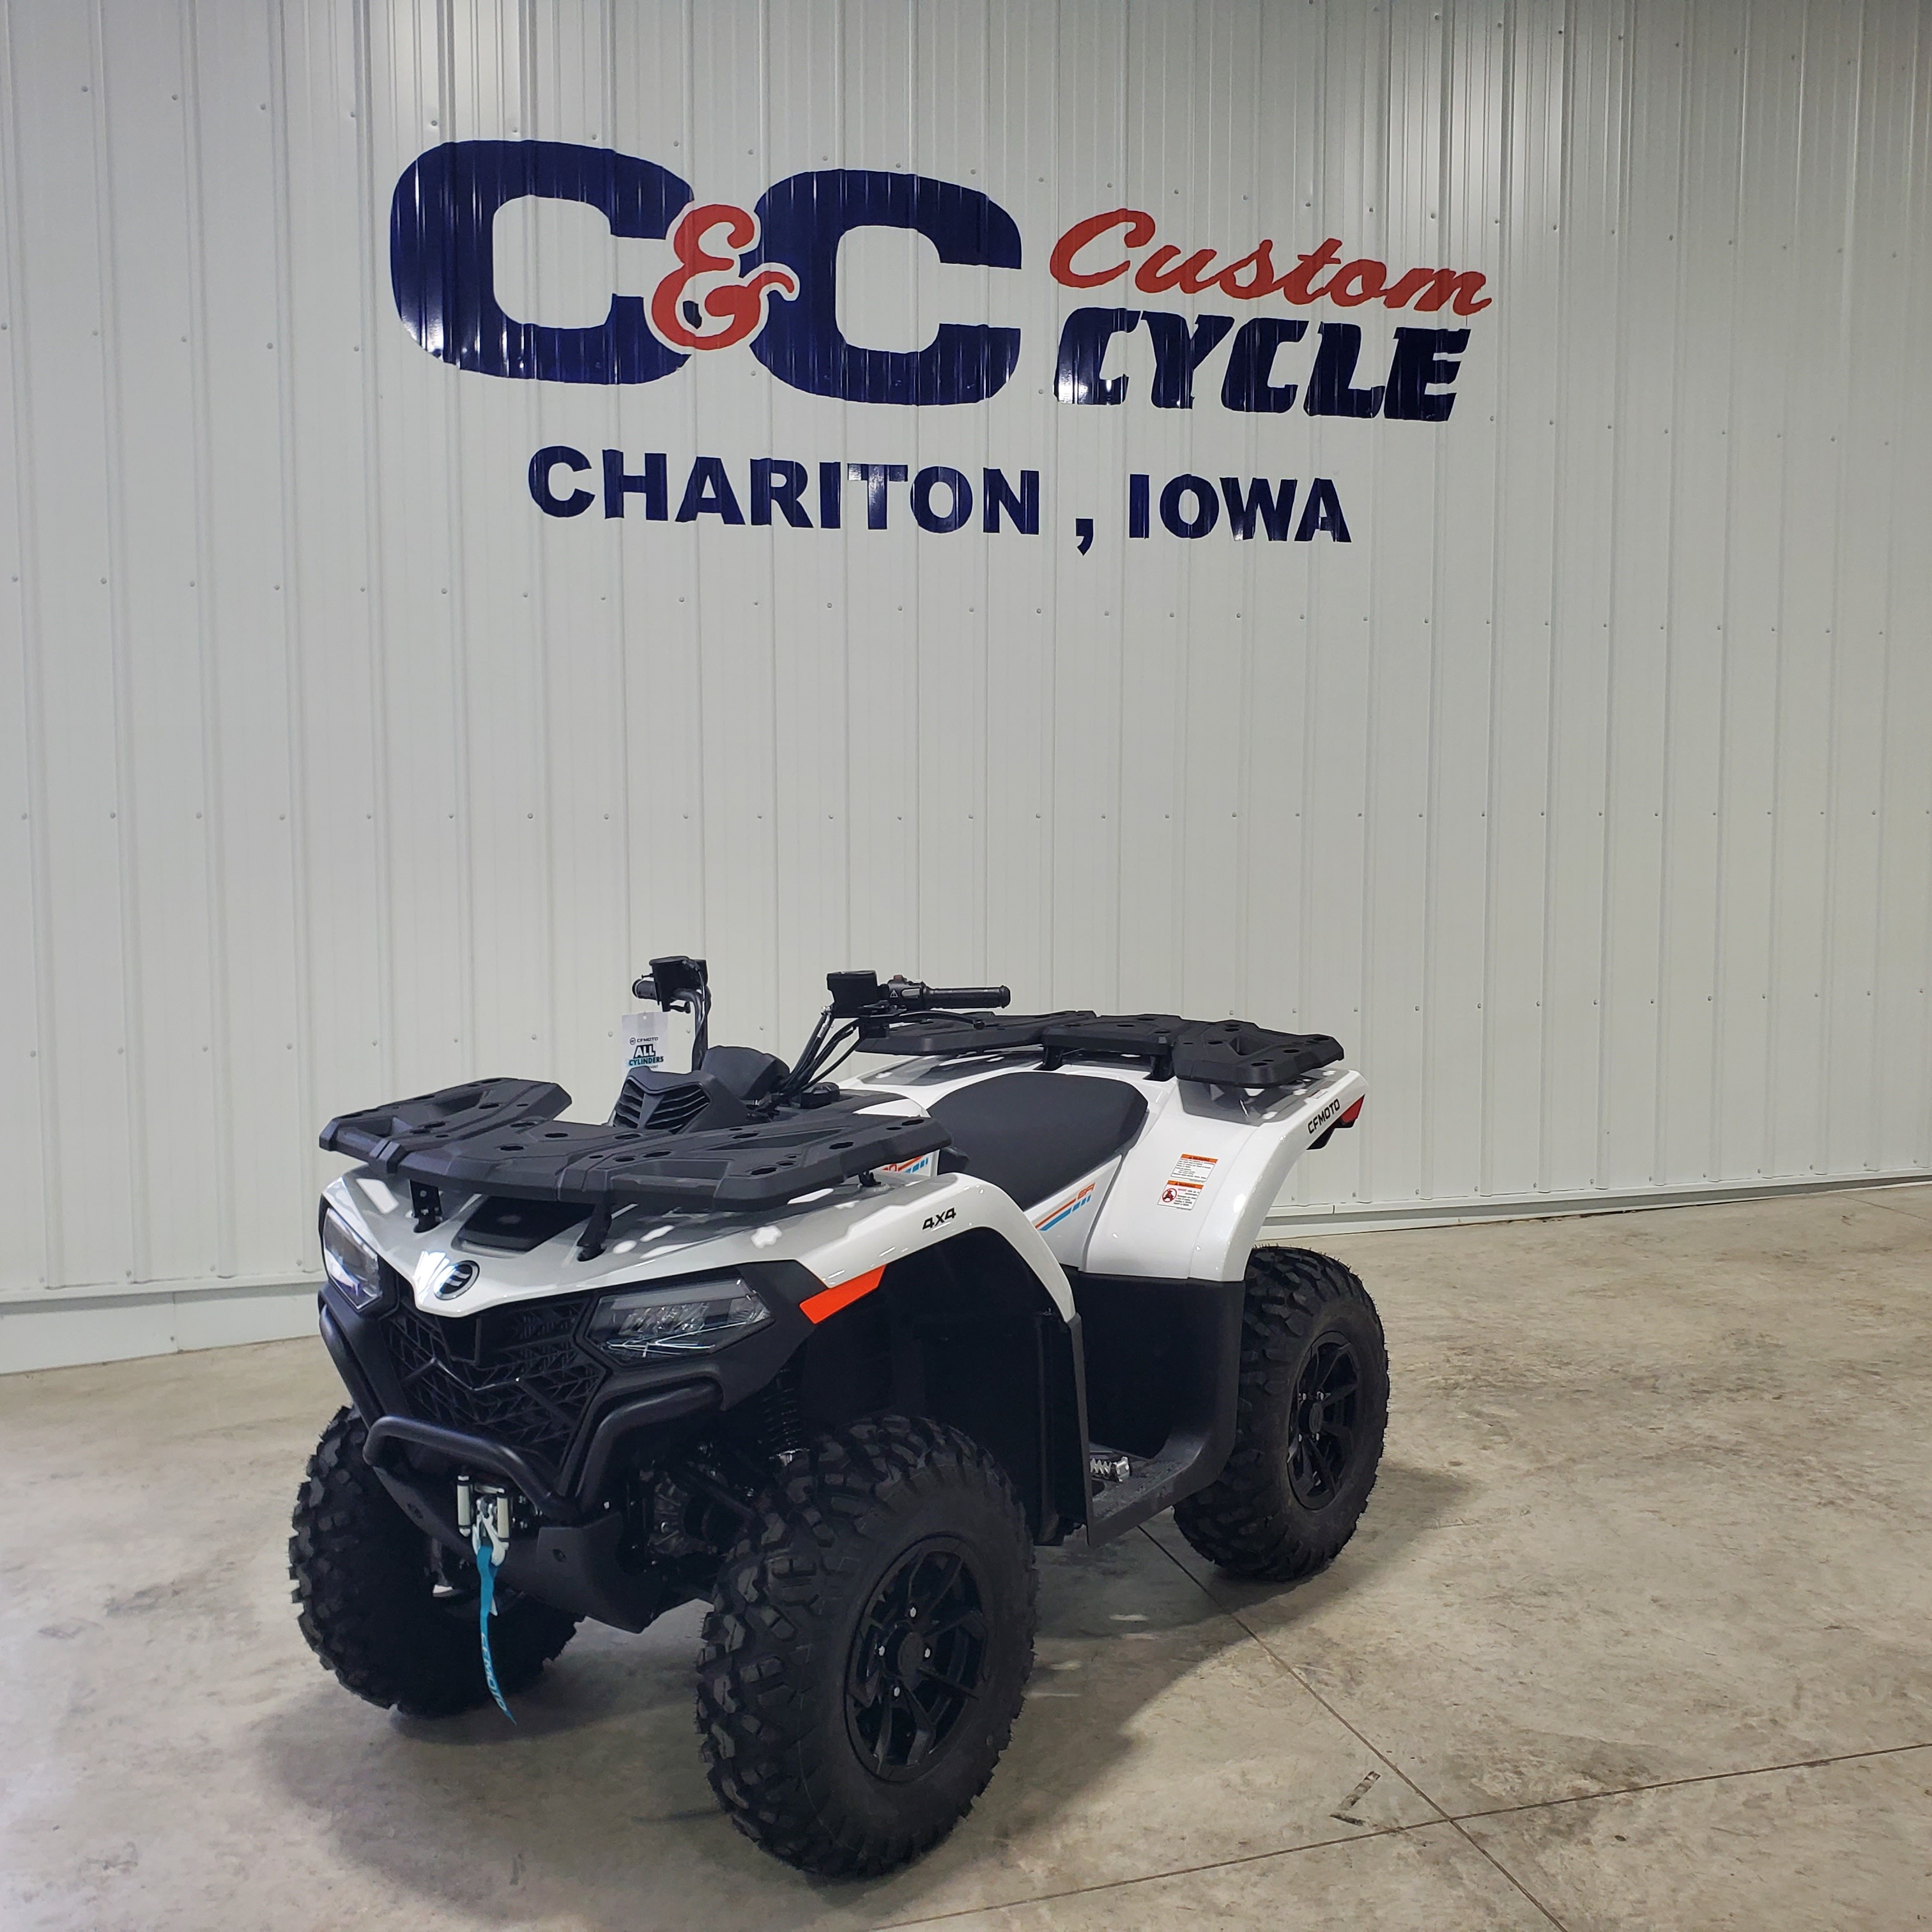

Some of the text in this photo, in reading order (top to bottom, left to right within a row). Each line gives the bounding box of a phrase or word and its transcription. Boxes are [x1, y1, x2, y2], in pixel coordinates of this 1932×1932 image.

[390, 140, 1022, 406] C&C
[1050, 209, 1491, 315] Custom
[1054, 307, 1471, 422] CYCLE
[529, 446, 1039, 535] CHARITON
[1130, 474, 1351, 542] IOWA
[629, 1056, 664, 1066] CYLINDERS
[634, 1045, 656, 1058] ALL
[1308, 1098, 1340, 1134] CFMOTO
